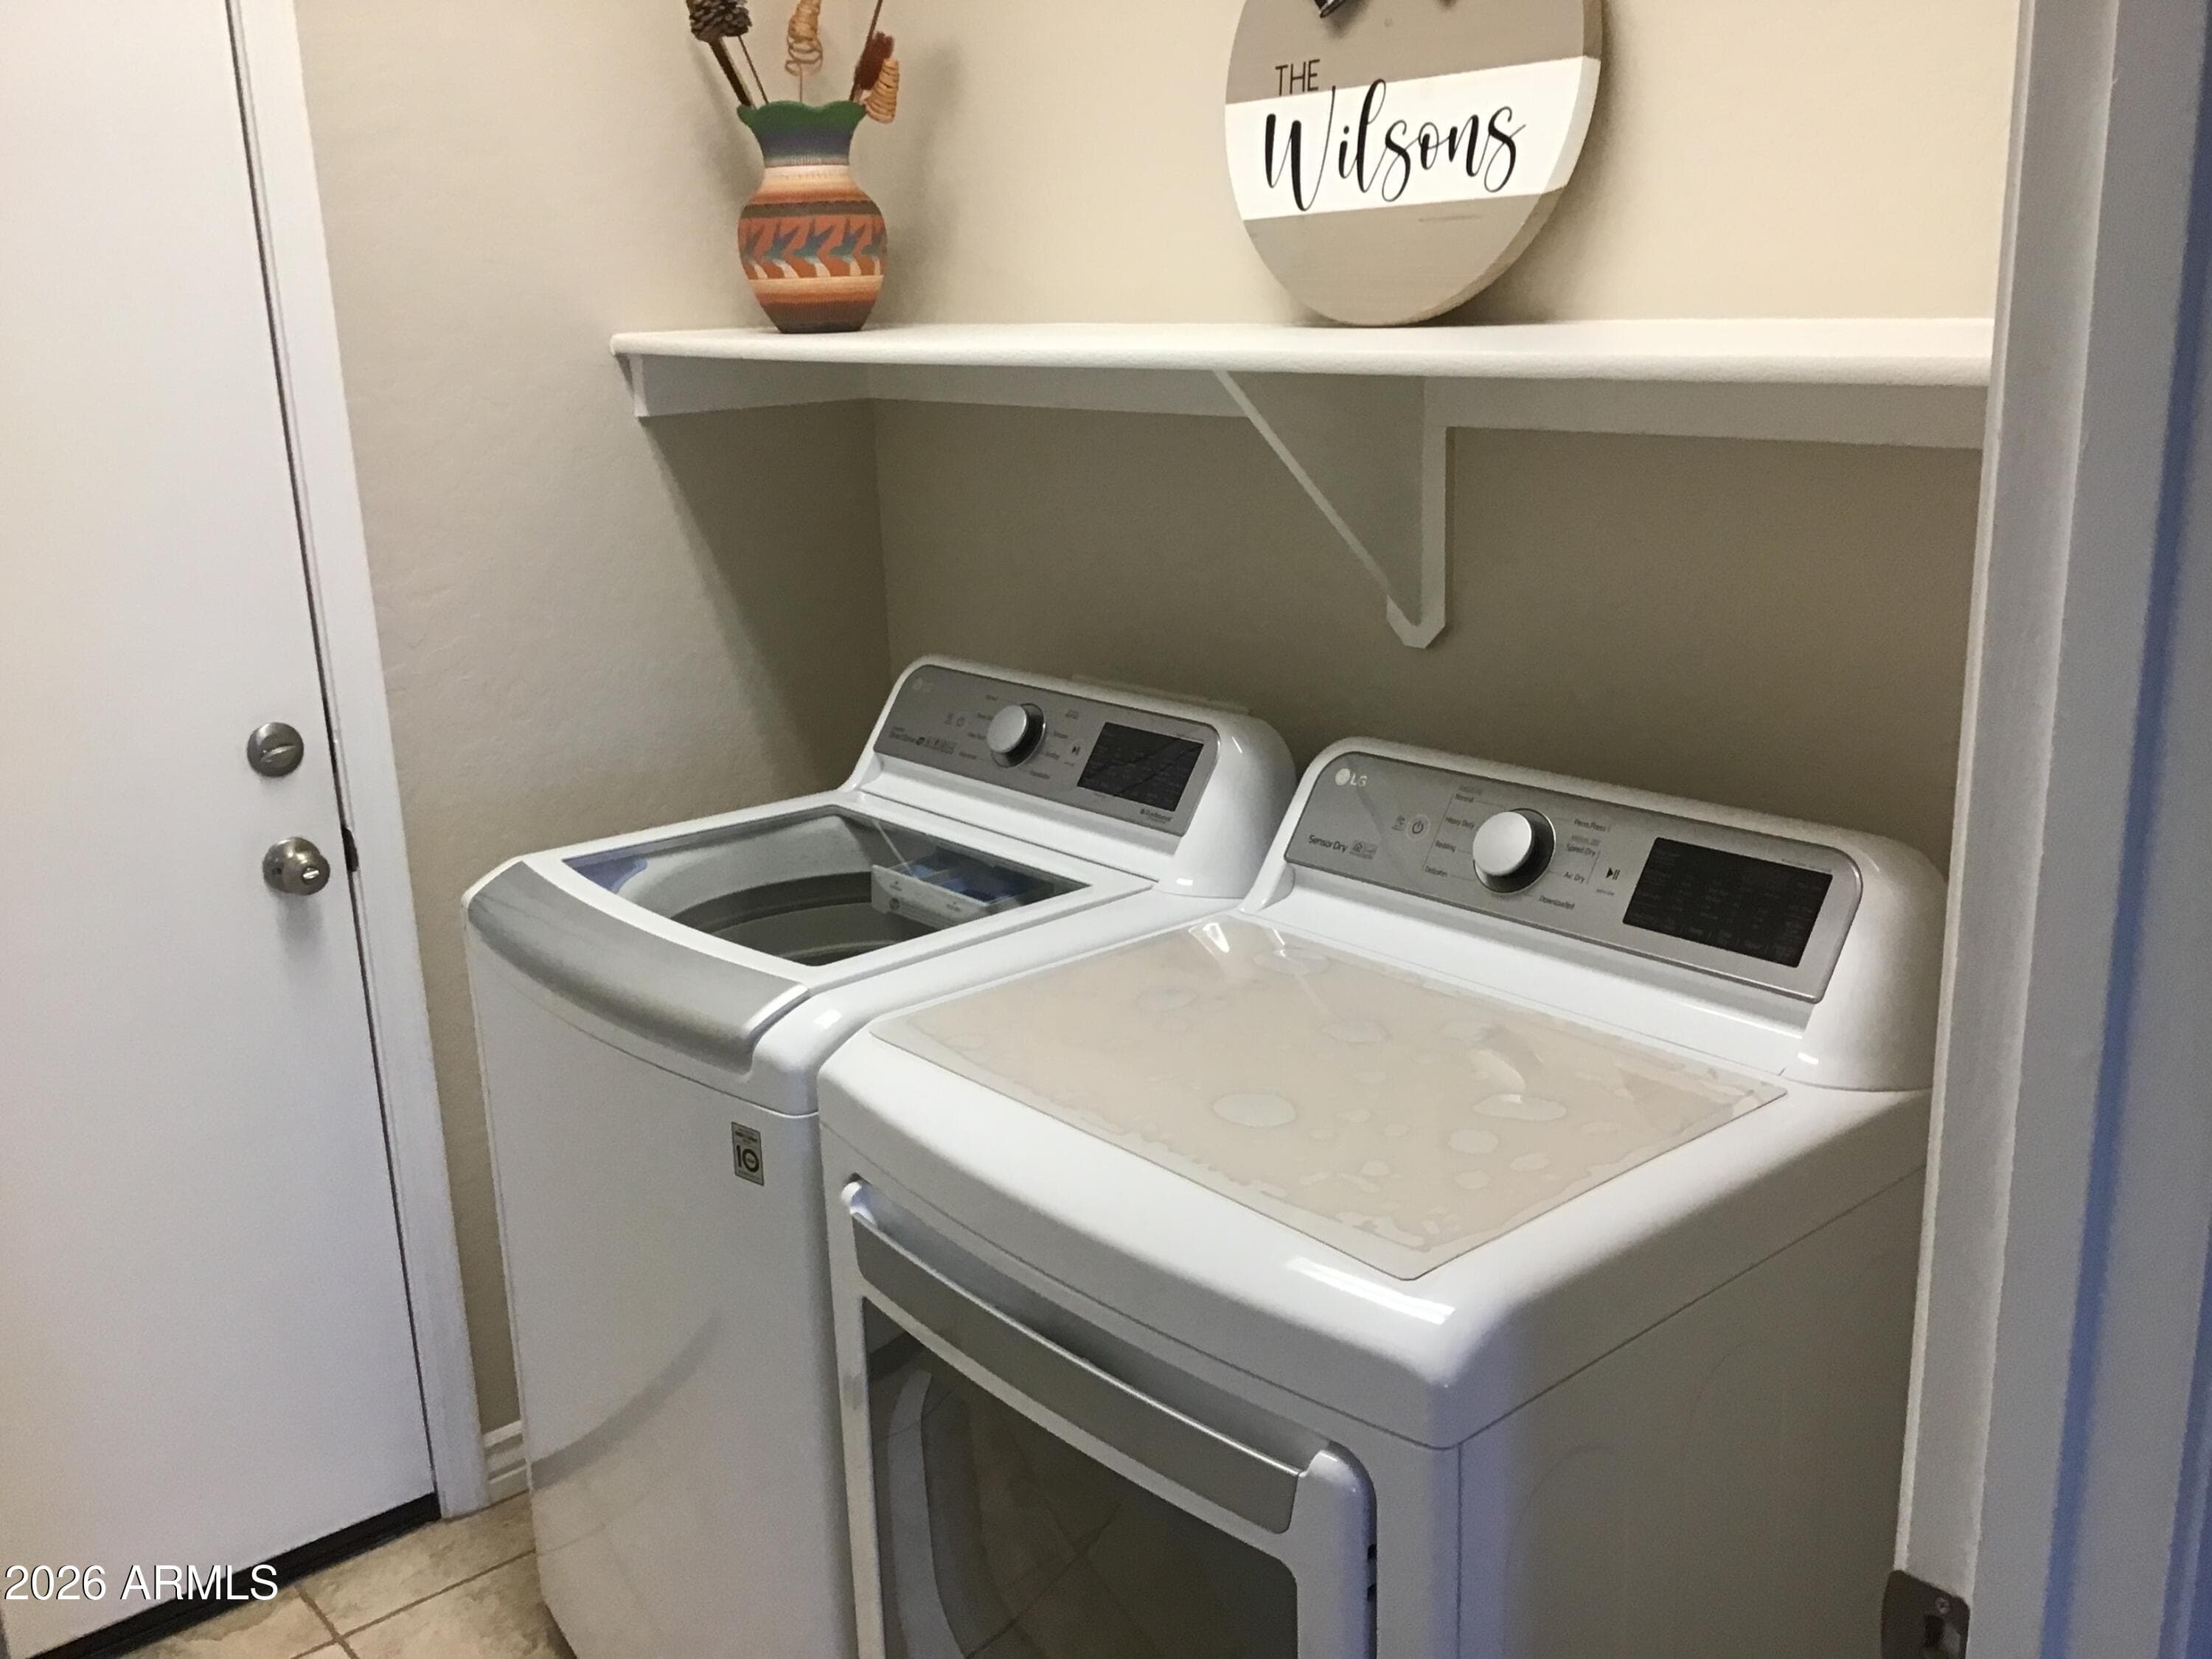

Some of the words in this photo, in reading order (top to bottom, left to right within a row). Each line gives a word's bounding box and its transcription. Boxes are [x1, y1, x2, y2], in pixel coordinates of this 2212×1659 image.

[1275, 59, 1321, 96] THE
[1265, 79, 1526, 211] Wilsons
[1309, 835, 1333, 849] Sensor
[1332, 841, 1348, 853] Dry
[1573, 874, 1585, 883] Dry
